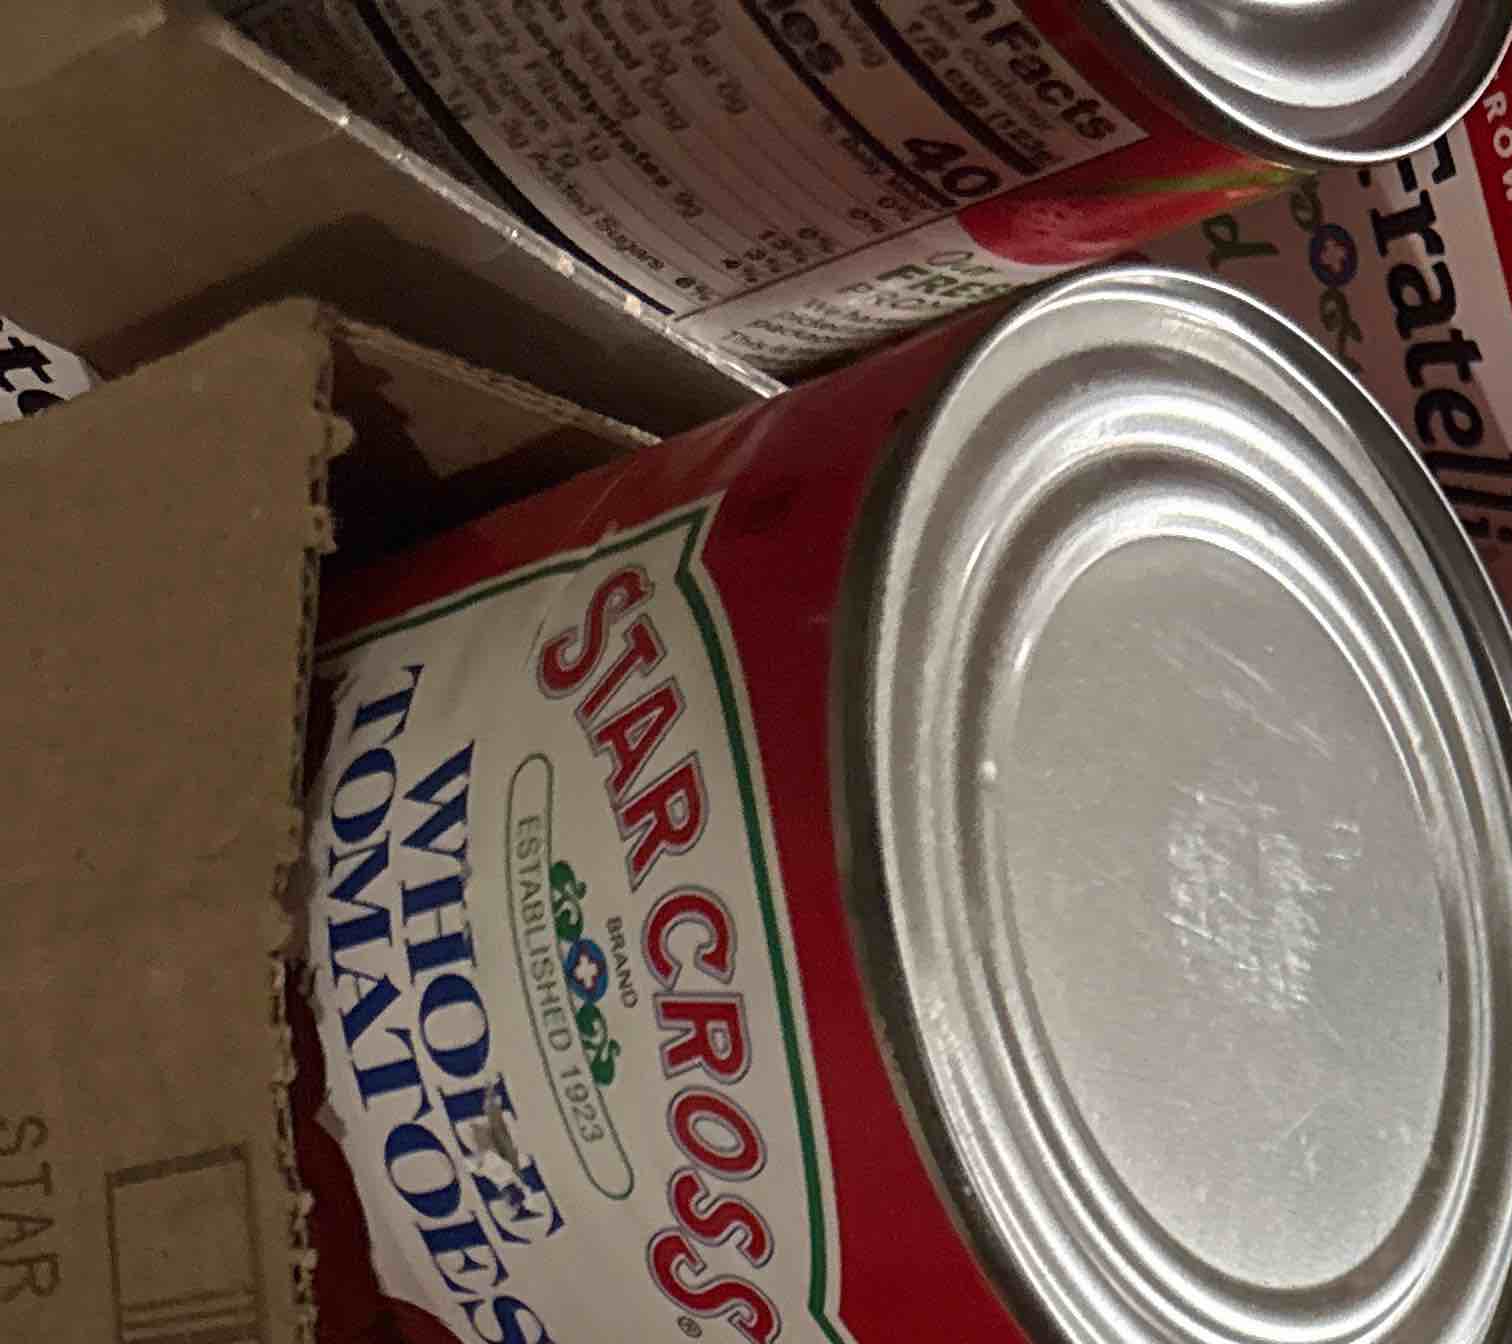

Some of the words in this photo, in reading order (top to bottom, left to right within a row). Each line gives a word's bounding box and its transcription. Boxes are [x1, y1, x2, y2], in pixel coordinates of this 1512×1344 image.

[902, 136, 1004, 200] 40
[981, 20, 1117, 141] Facts
[532, 566, 712, 888] STAR
[398, 739, 565, 1246] WHOLE
[514, 813, 575, 1052] ESTABLISHED
[553, 1064, 605, 1144] 1923
[606, 916, 638, 1008] BRAND
[0, 1115, 63, 1303] STAR
